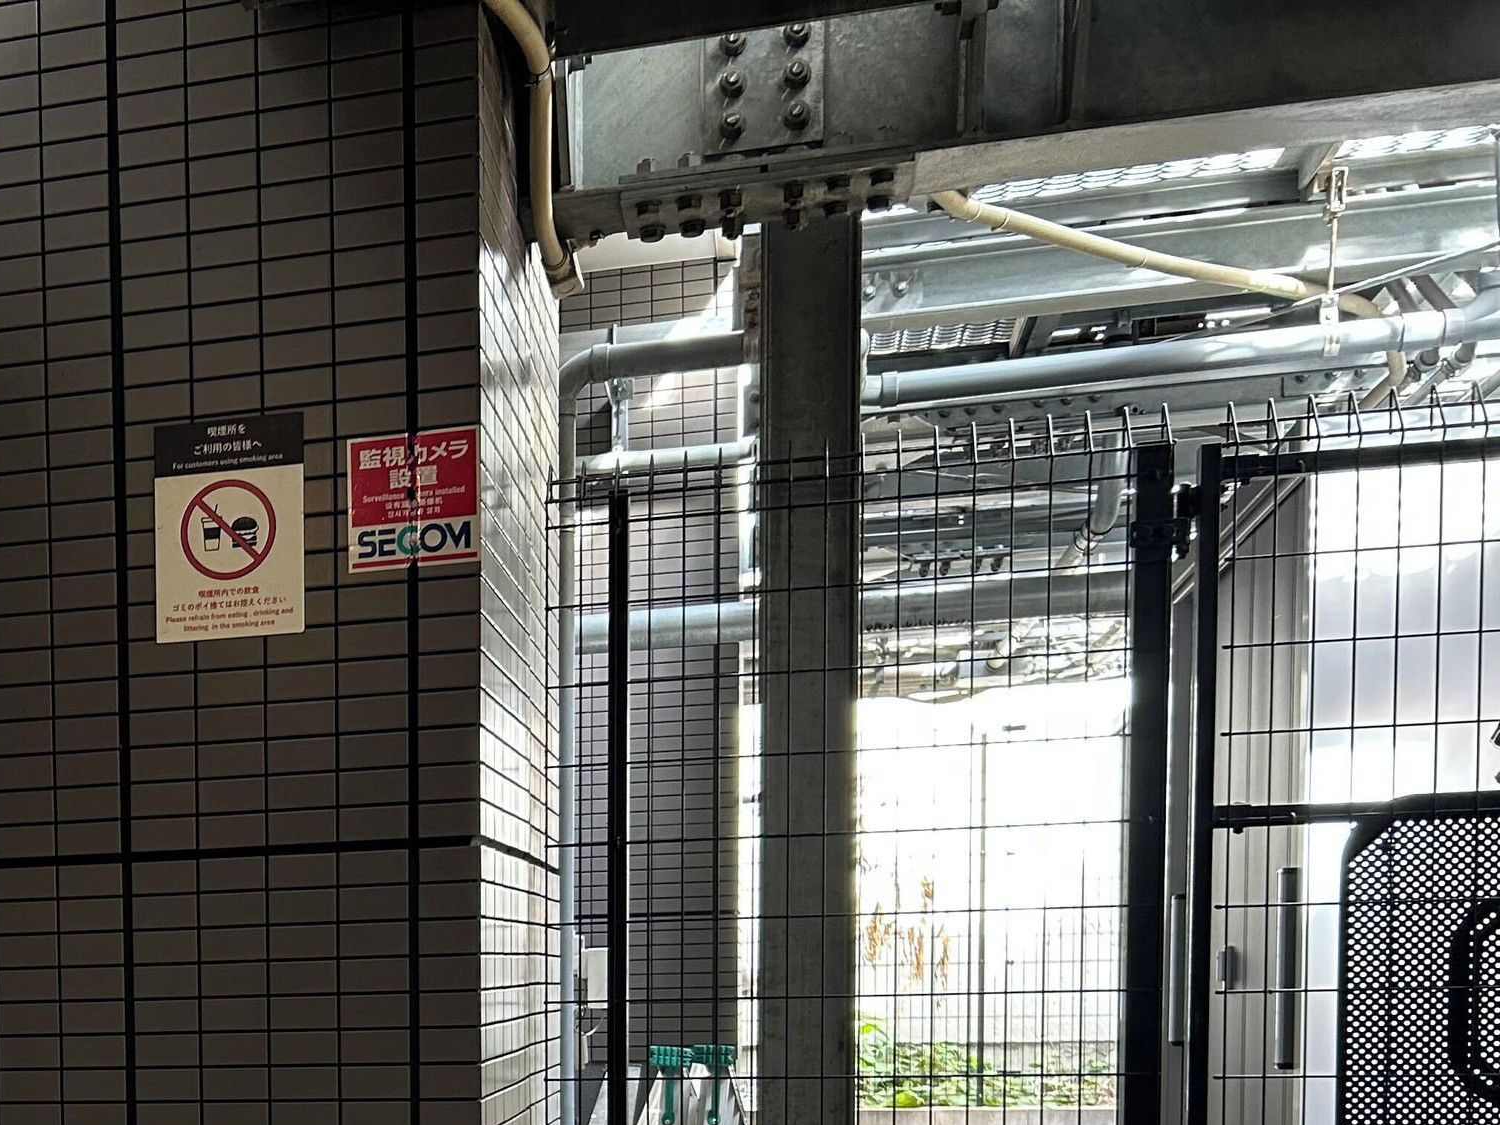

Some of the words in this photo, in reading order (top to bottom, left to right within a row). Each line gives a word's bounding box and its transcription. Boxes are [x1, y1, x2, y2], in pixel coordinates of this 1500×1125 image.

[193, 439, 262, 455] ご利用の皆様へ
[359, 438, 469, 470] 監視カメラ
[220, 457, 238, 466] using
[239, 454, 267, 463] smoking
[389, 465, 438, 490] 設置
[358, 520, 471, 559] SECOM
[211, 612, 227, 620] from
[281, 606, 294, 614] and
